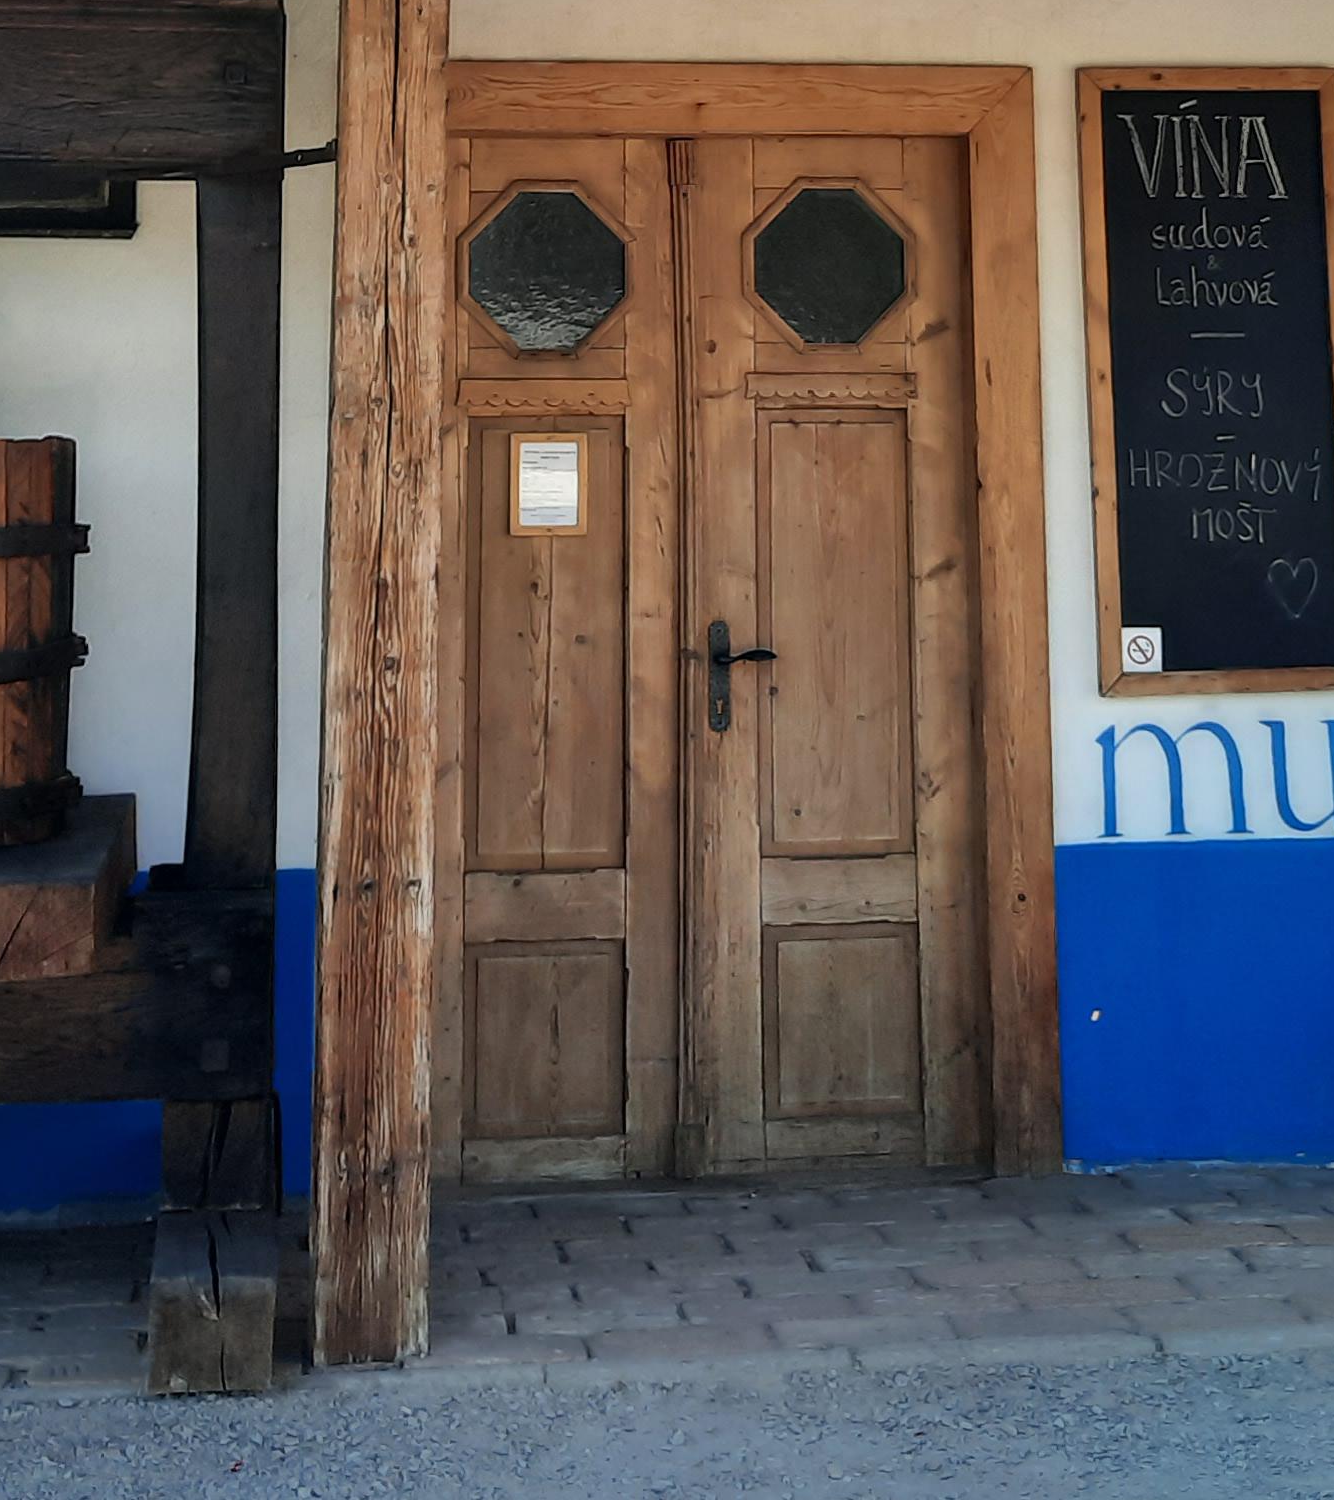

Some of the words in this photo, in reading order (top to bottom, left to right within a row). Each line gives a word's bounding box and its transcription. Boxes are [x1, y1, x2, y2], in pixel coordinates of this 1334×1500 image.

[1115, 97, 1289, 200] VÍNA
[1150, 206, 1271, 251] sudová
[1159, 365, 1265, 418] SÝRY
[1190, 500, 1278, 544] MOŠT
